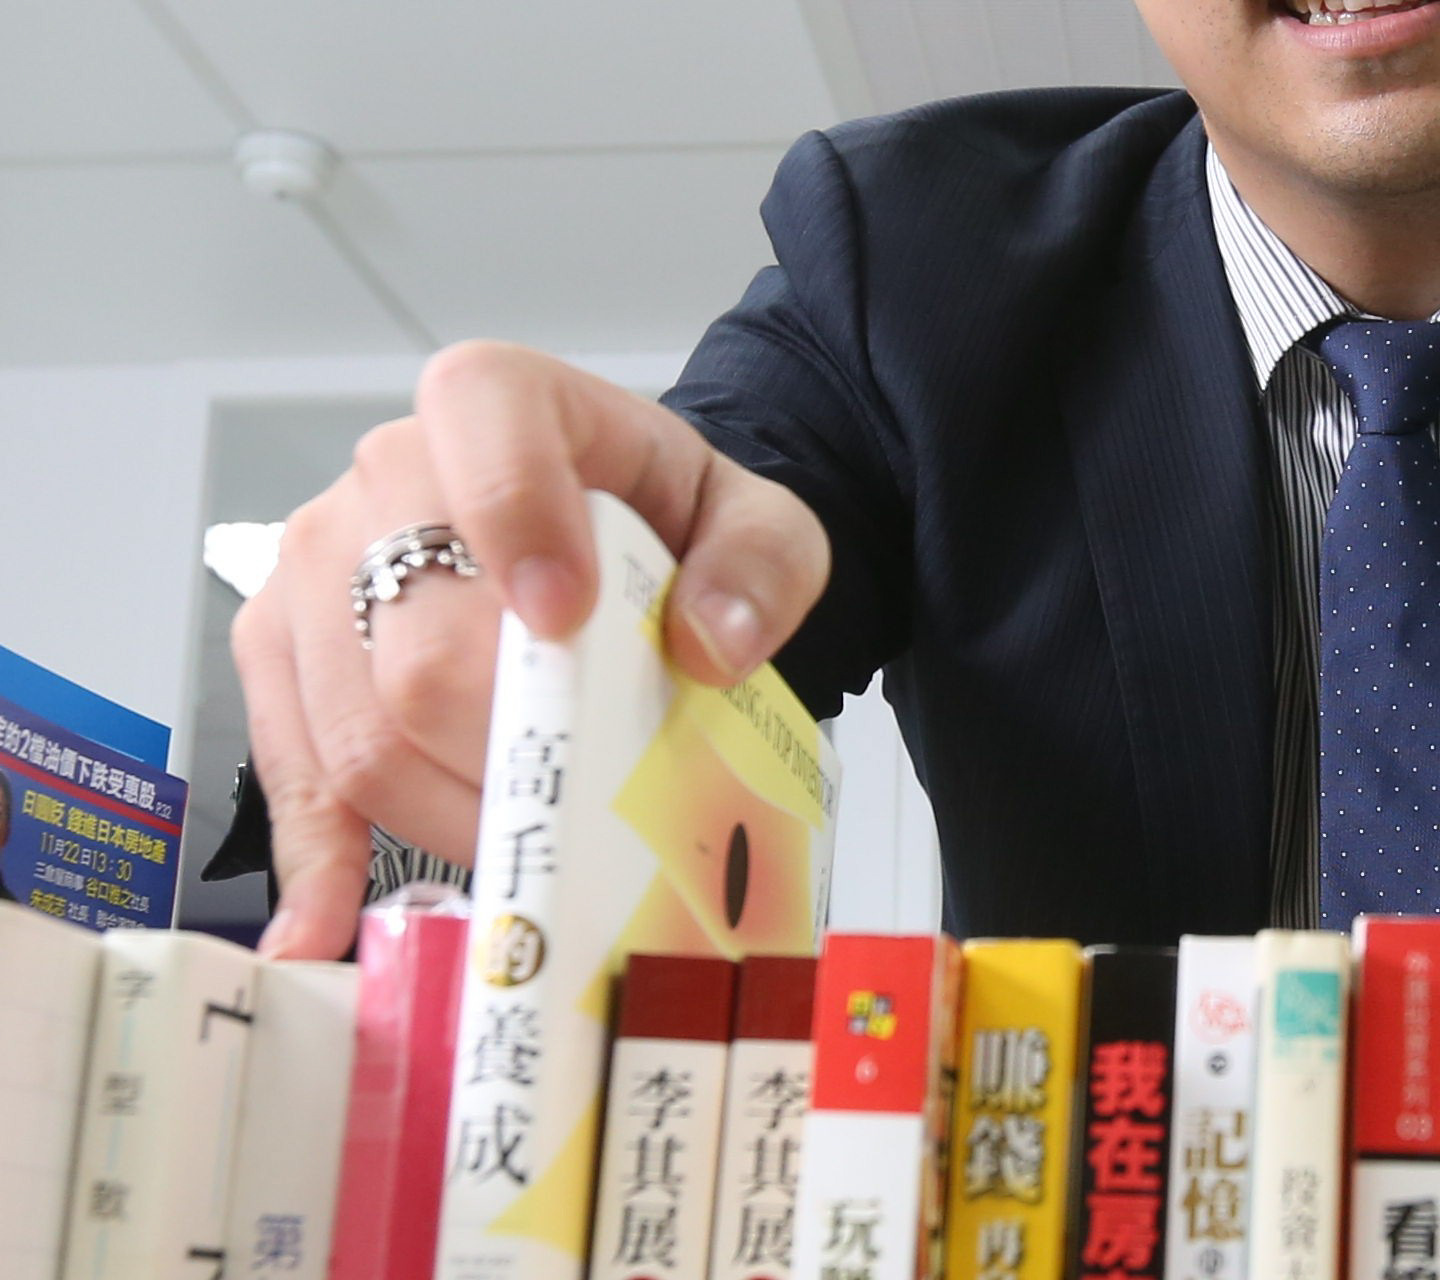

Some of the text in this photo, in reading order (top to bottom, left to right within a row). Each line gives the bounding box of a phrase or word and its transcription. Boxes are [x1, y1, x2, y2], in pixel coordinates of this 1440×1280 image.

[453, 725, 574, 1188] 高手的養成
